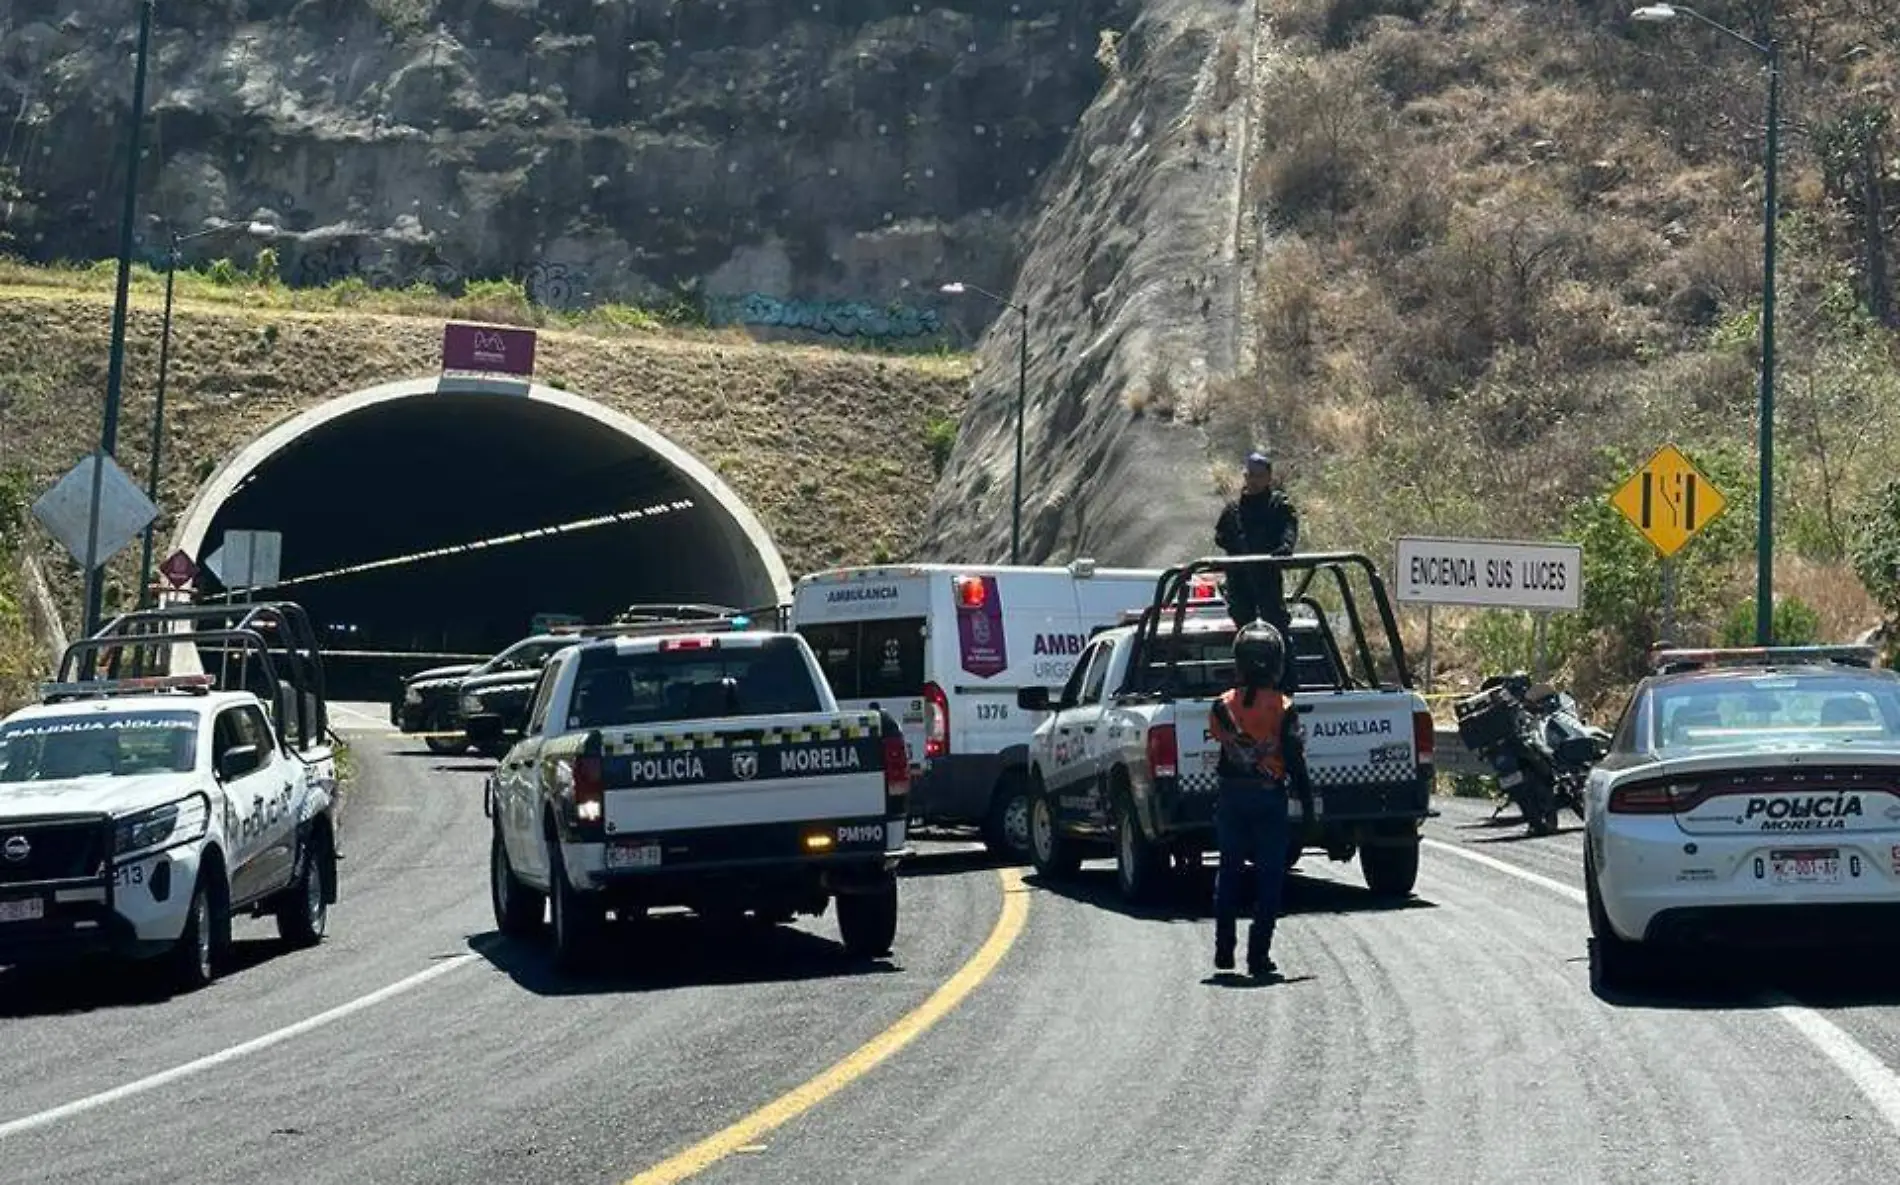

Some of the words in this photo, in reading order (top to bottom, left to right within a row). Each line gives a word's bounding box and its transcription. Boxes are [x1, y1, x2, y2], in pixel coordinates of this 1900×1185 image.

[1411, 556, 1477, 587] ENCIENDA
[1486, 559, 1513, 588] SUS
[1523, 561, 1567, 590] LUCES
[827, 586, 898, 602] AMBULANCIA
[976, 703, 1008, 720] 1376
[1313, 719, 1392, 738] AUXILIAR
[630, 751, 705, 781] POLICÍA
[780, 746, 861, 772] MORELIA
[1745, 787, 1863, 819] POLICÍA
[1760, 818, 1846, 831] MORELIA
